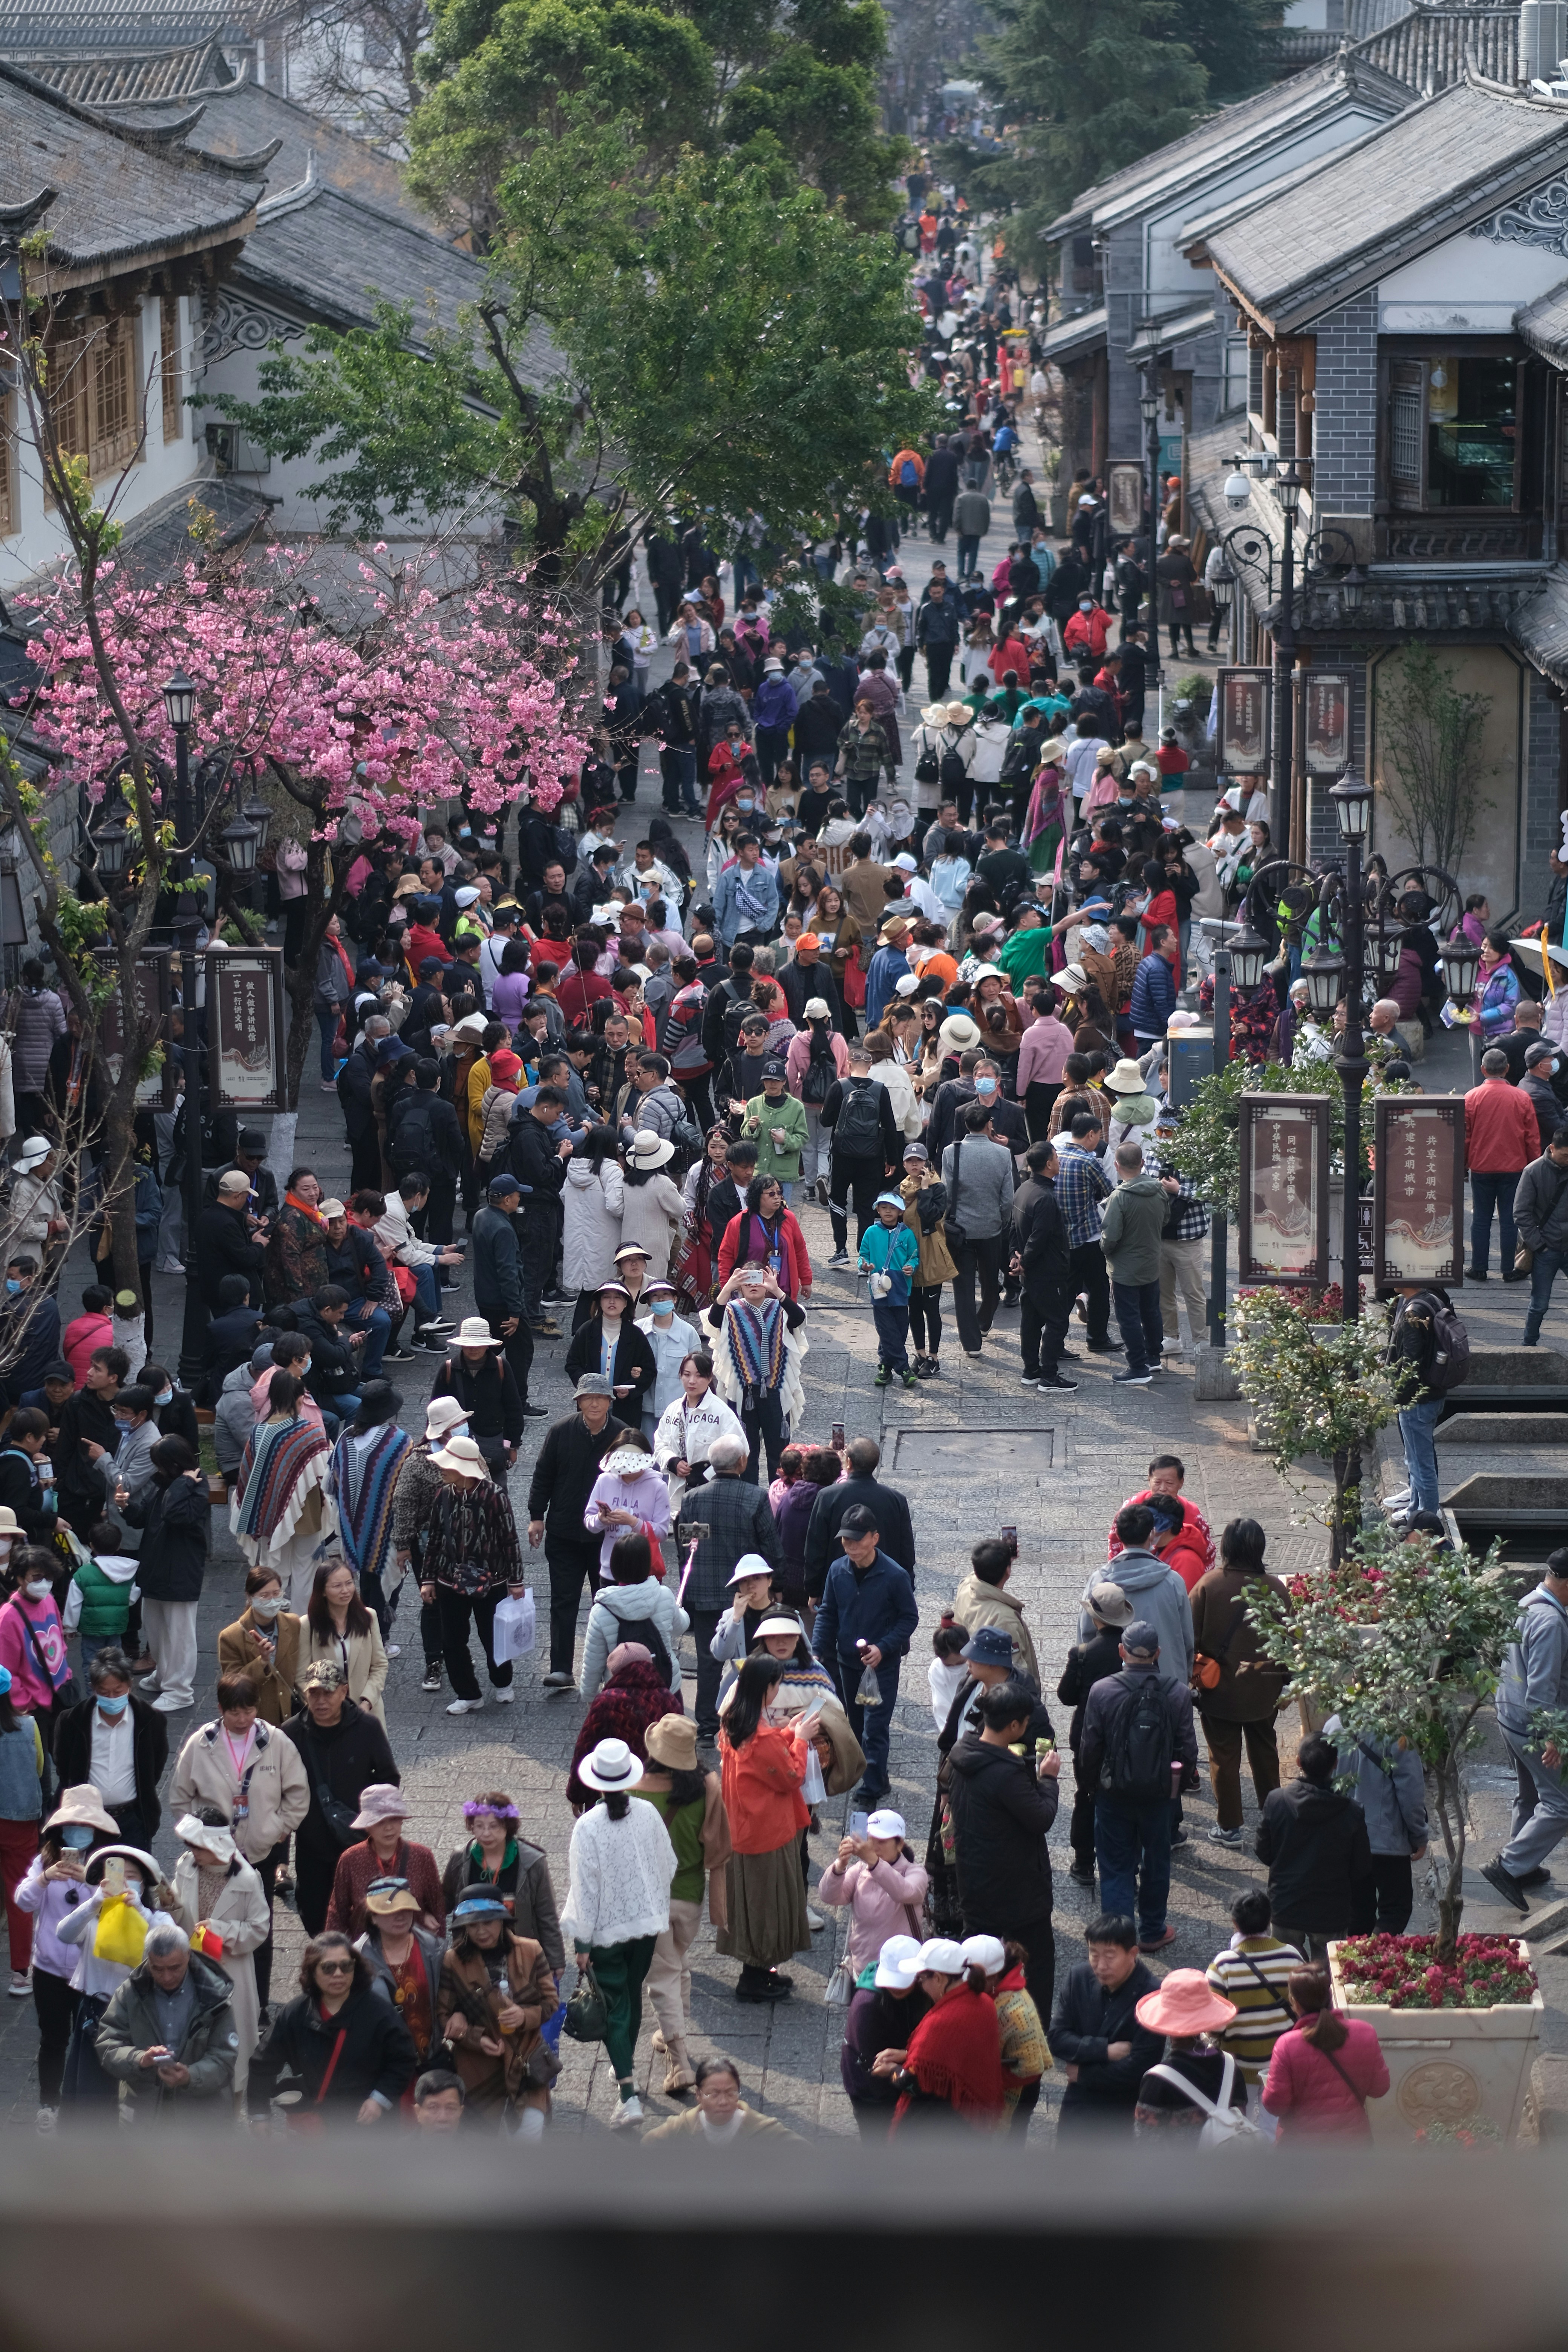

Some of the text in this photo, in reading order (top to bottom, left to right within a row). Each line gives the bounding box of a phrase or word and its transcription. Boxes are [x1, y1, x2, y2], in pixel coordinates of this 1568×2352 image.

[821, 937, 831, 949] A
[233, 974, 242, 1031] 一言一行讲文明
[246, 982, 256, 1042] 做人做事讲诚信
[1271, 1123, 1281, 1192] 中华民族一家亲
[1286, 1136, 1296, 1204] 同心共筑中国梦
[1404, 1119, 1416, 1197] 共建文明城市
[1425, 1135, 1437, 1214] 共享文明成果
